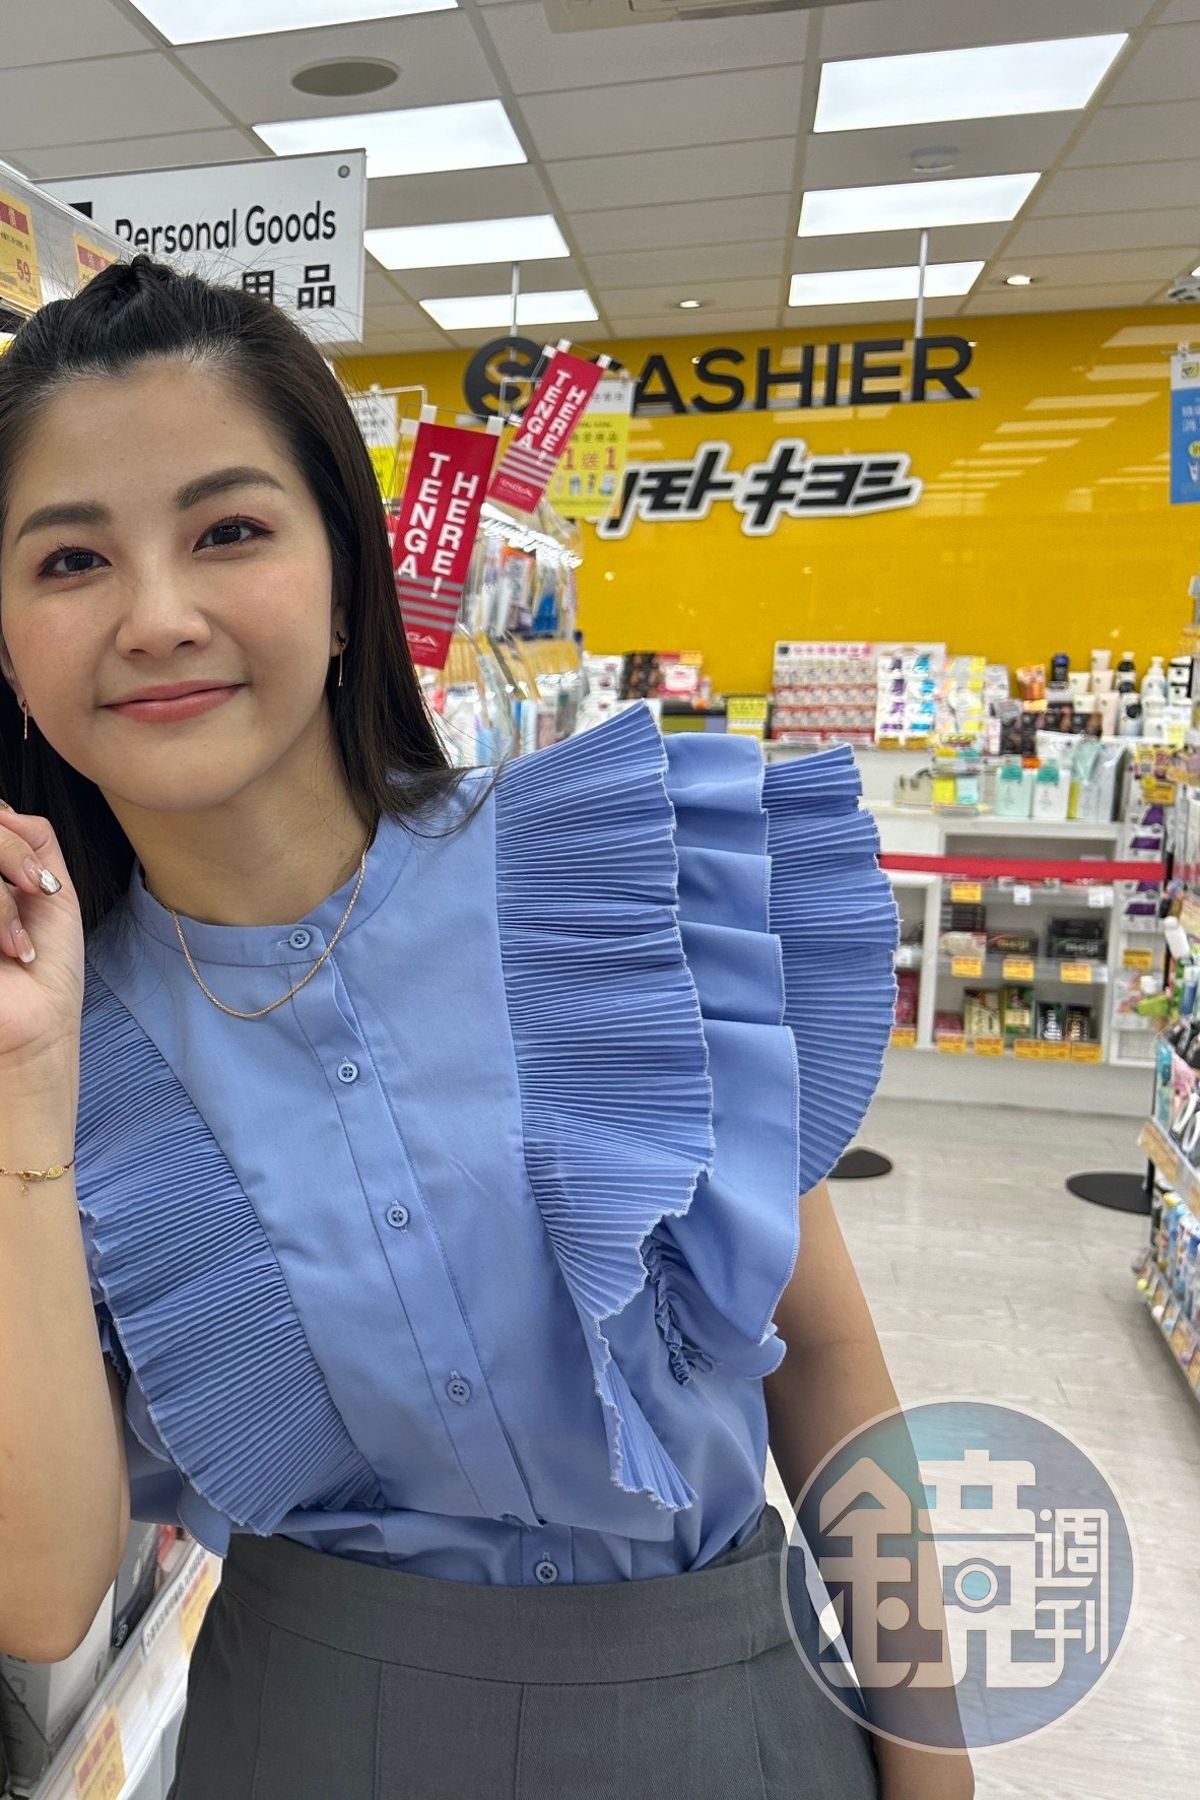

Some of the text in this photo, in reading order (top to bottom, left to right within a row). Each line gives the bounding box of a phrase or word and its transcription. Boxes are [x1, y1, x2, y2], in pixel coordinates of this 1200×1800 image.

[116, 201, 336, 255] Personal Goods
[17, 259, 31, 282] 59
[515, 369, 571, 450] TENGA
[600, 334, 975, 416] ASHIER
[537, 385, 587, 465] HERE!
[398, 452, 450, 579] TENGA
[606, 446, 918, 530] モトキヨシ
[430, 471, 479, 599] HERE!
